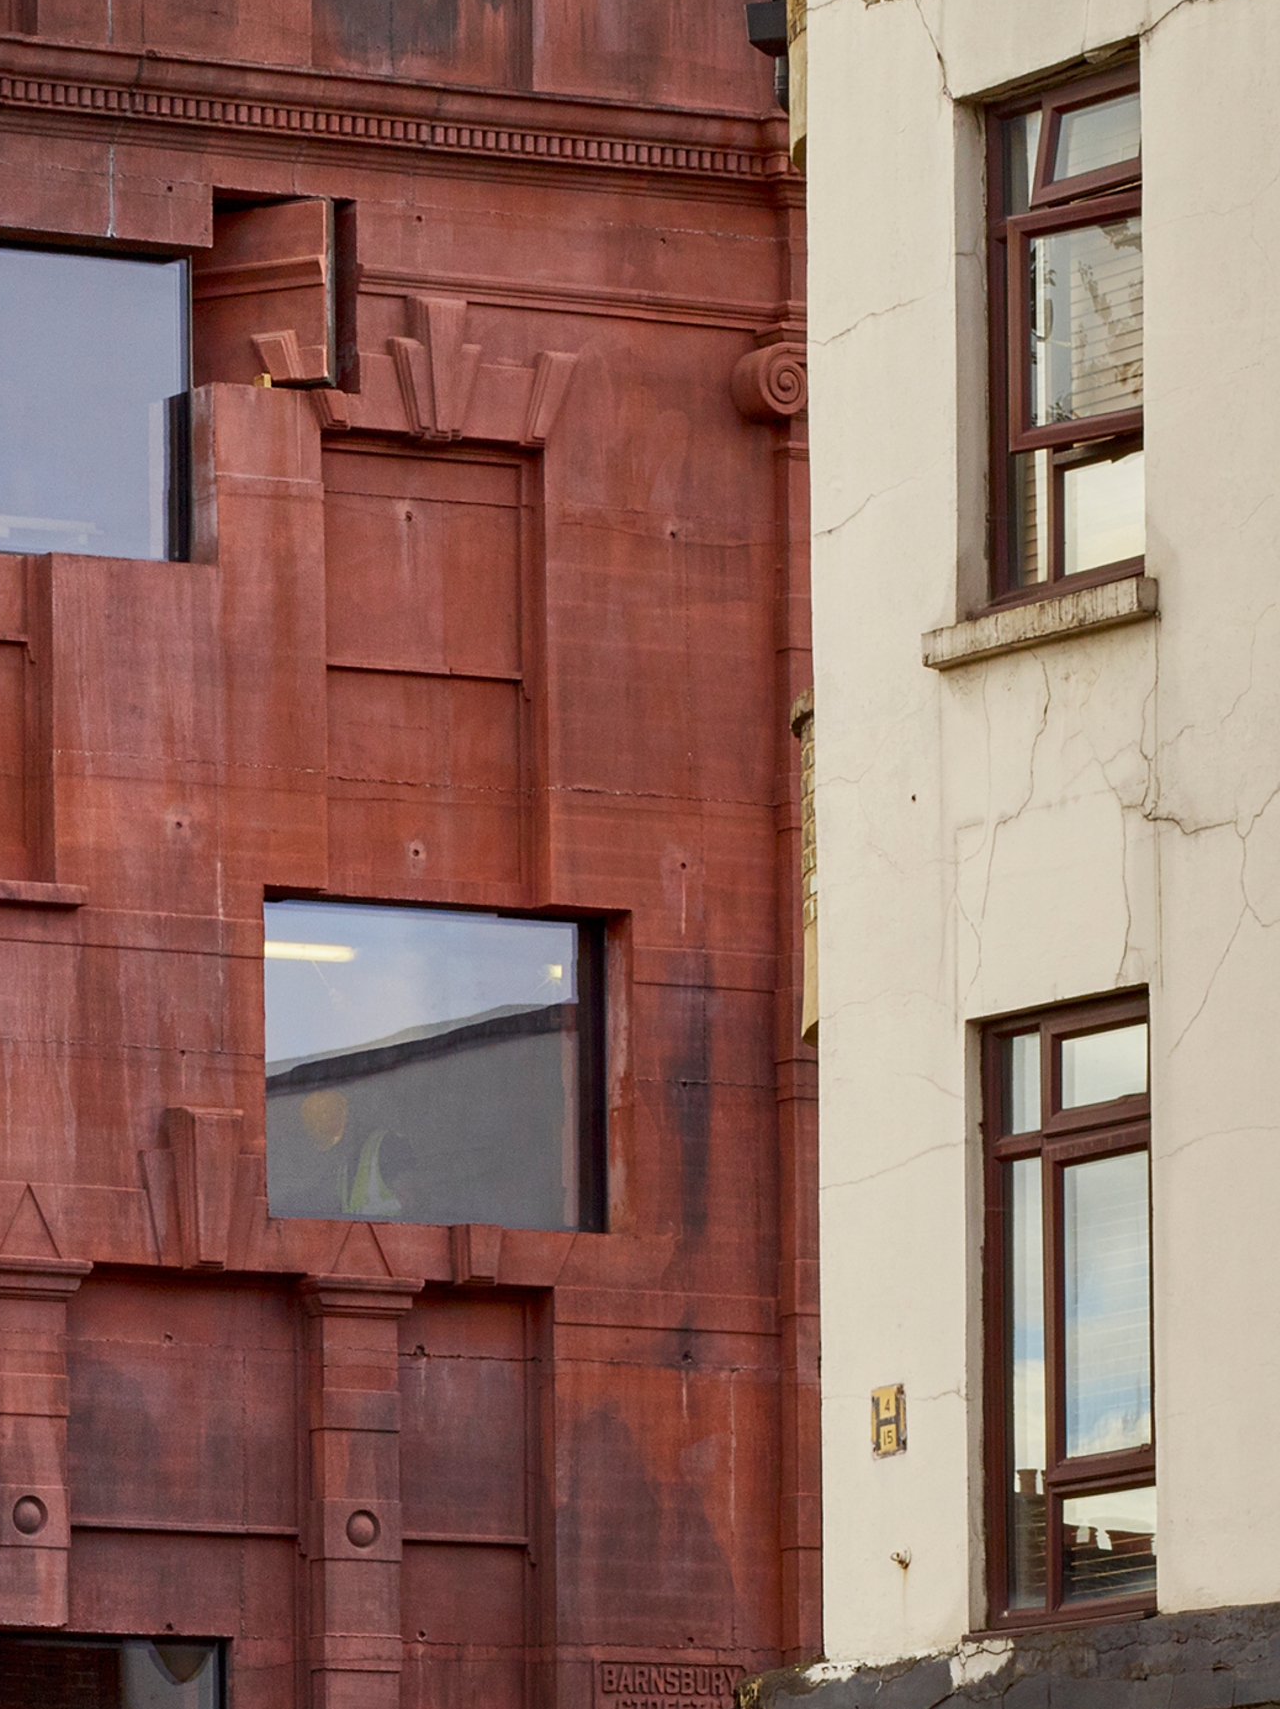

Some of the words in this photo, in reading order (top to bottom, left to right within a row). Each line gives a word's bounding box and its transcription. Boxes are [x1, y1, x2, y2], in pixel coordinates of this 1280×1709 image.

[884, 1398, 891, 1412] 4
[883, 1430, 894, 1446] 15
[601, 1665, 739, 1695] BARNSBURY
